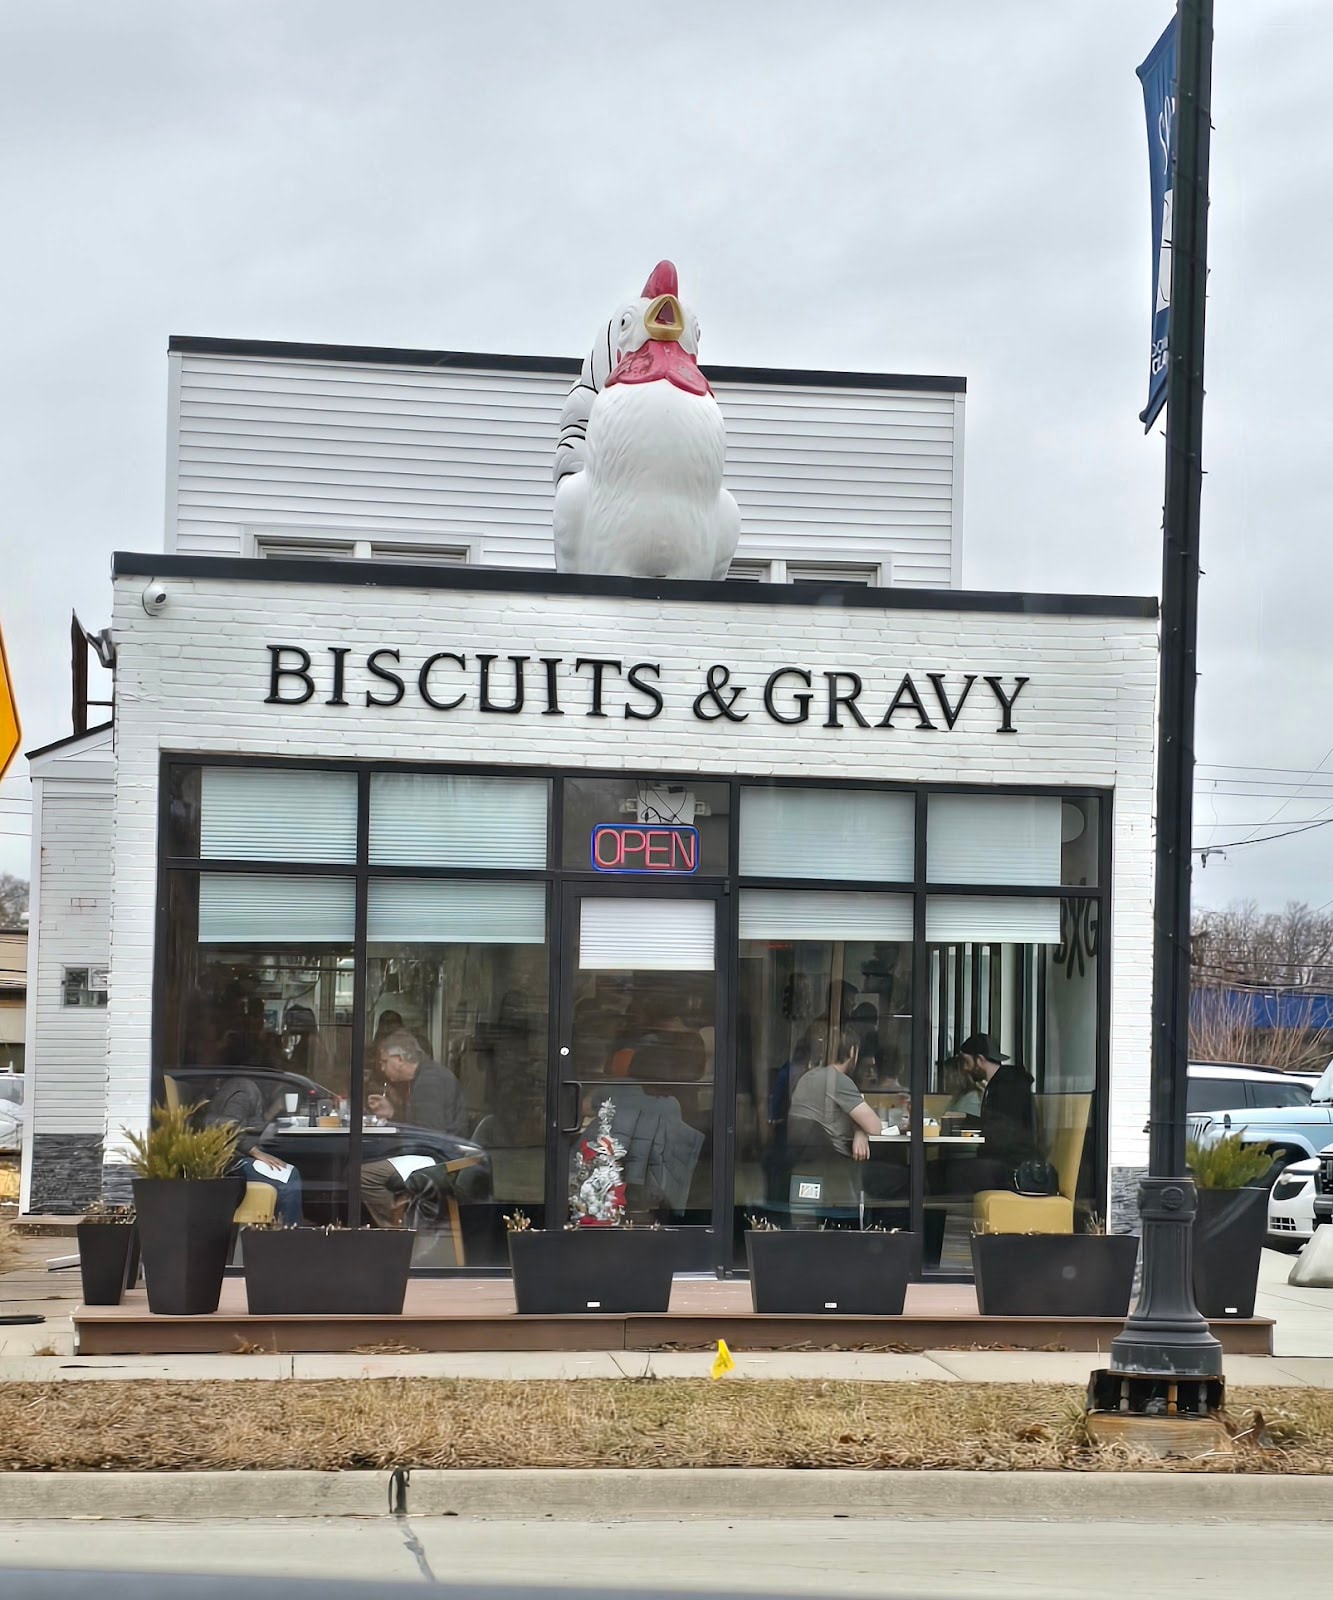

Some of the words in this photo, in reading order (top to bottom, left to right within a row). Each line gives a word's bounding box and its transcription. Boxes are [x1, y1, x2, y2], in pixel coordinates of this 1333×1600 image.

[264, 644, 664, 721] BISCUITS
[692, 664, 750, 722] &
[763, 667, 1030, 733] GRAVY
[594, 828, 696, 870] OPEN
